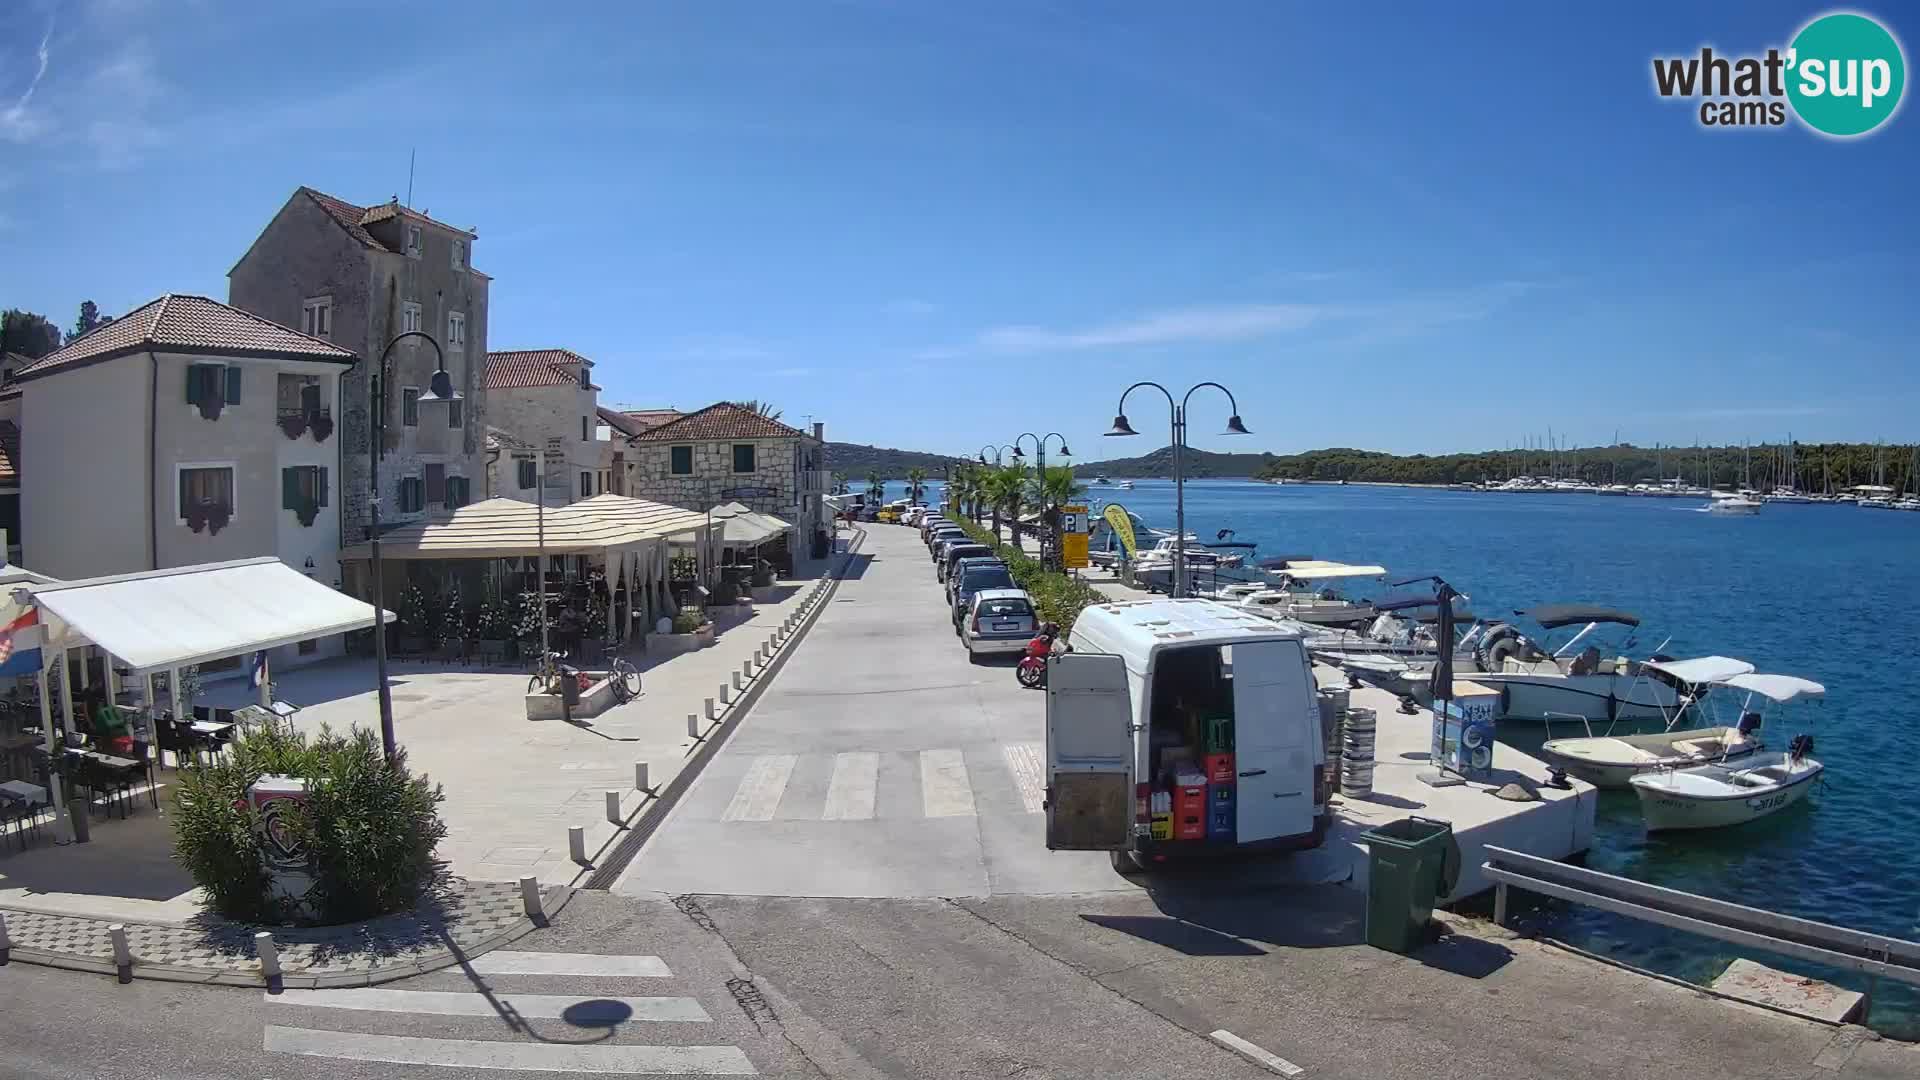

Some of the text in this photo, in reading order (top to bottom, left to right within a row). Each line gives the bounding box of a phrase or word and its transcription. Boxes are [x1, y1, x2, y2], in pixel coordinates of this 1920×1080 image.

[1065, 515, 1076, 531] P
[1463, 703, 1495, 713] RENT
[1471, 712, 1495, 722] BOAT
